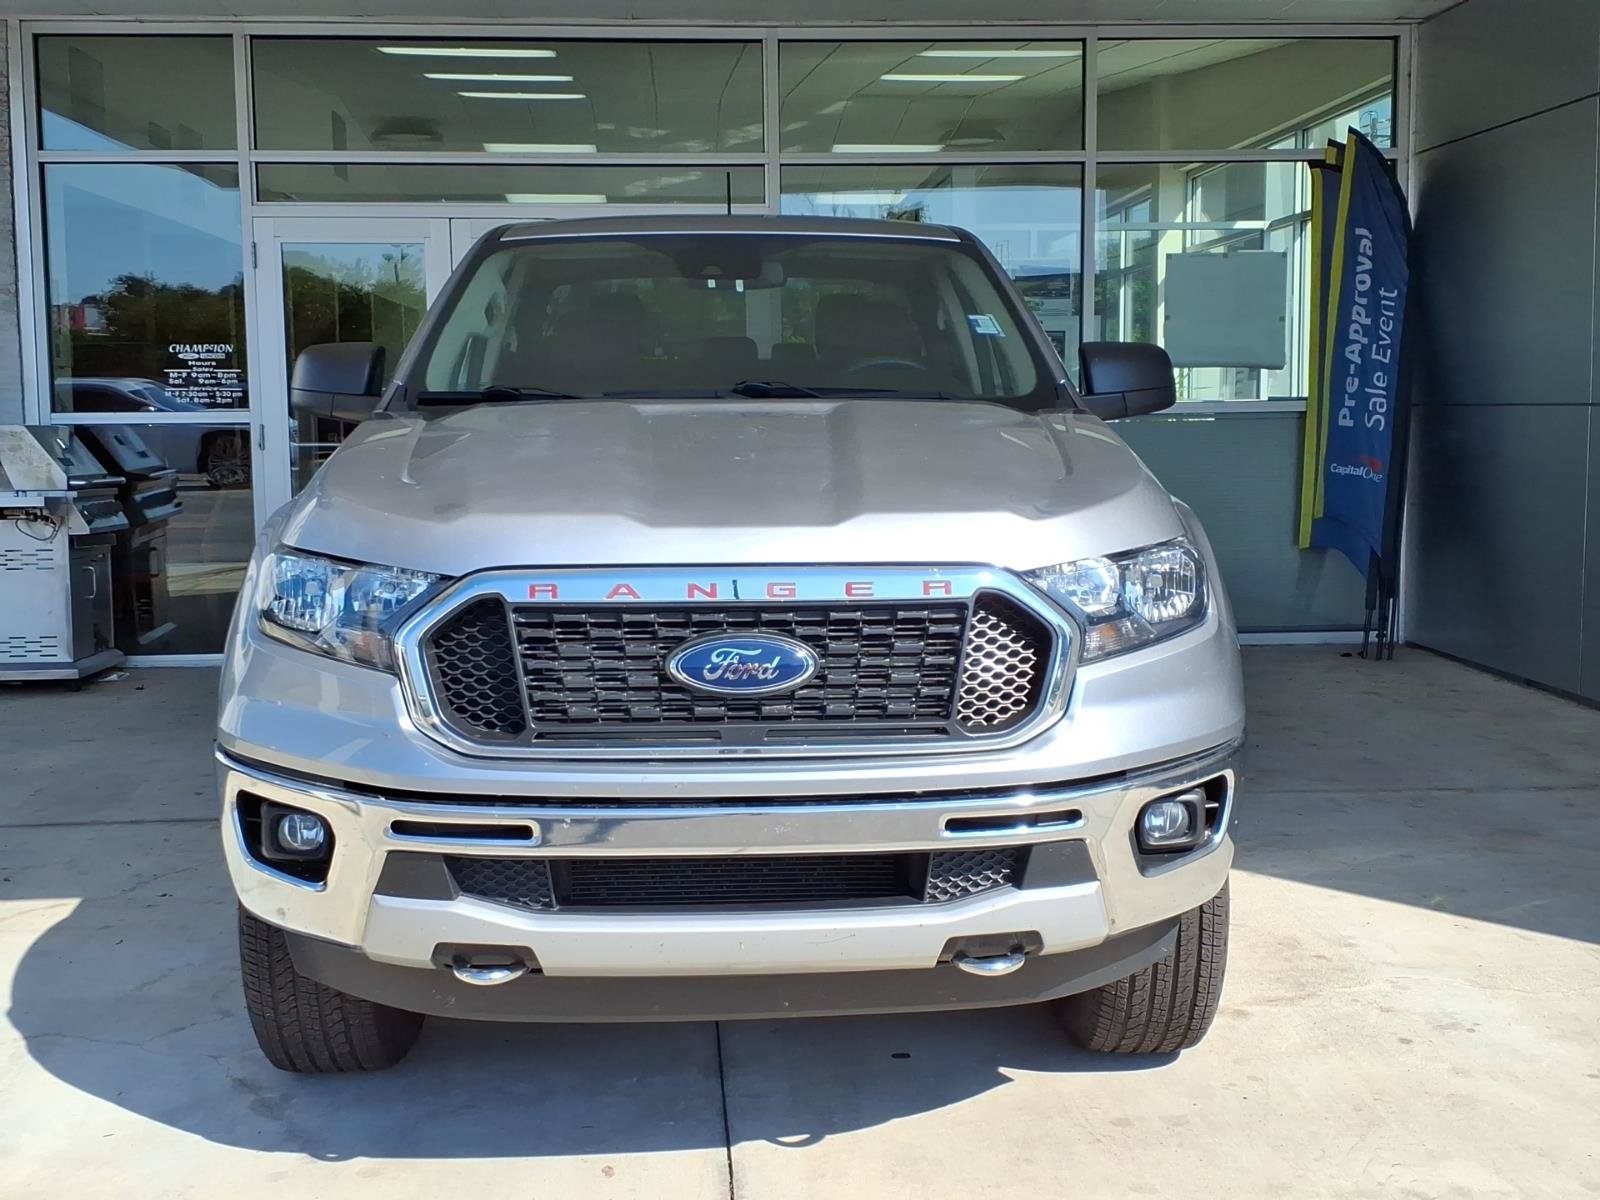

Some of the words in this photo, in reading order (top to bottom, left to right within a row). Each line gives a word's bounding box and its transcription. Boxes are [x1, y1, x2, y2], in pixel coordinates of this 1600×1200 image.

[1338, 227, 1373, 427] Pre-Approval
[1371, 286, 1399, 363] Event
[169, 344, 234, 353] CHAMPION
[1365, 371, 1388, 431] Sale
[528, 580, 953, 601] RANGER
[703, 647, 781, 681] Ford
